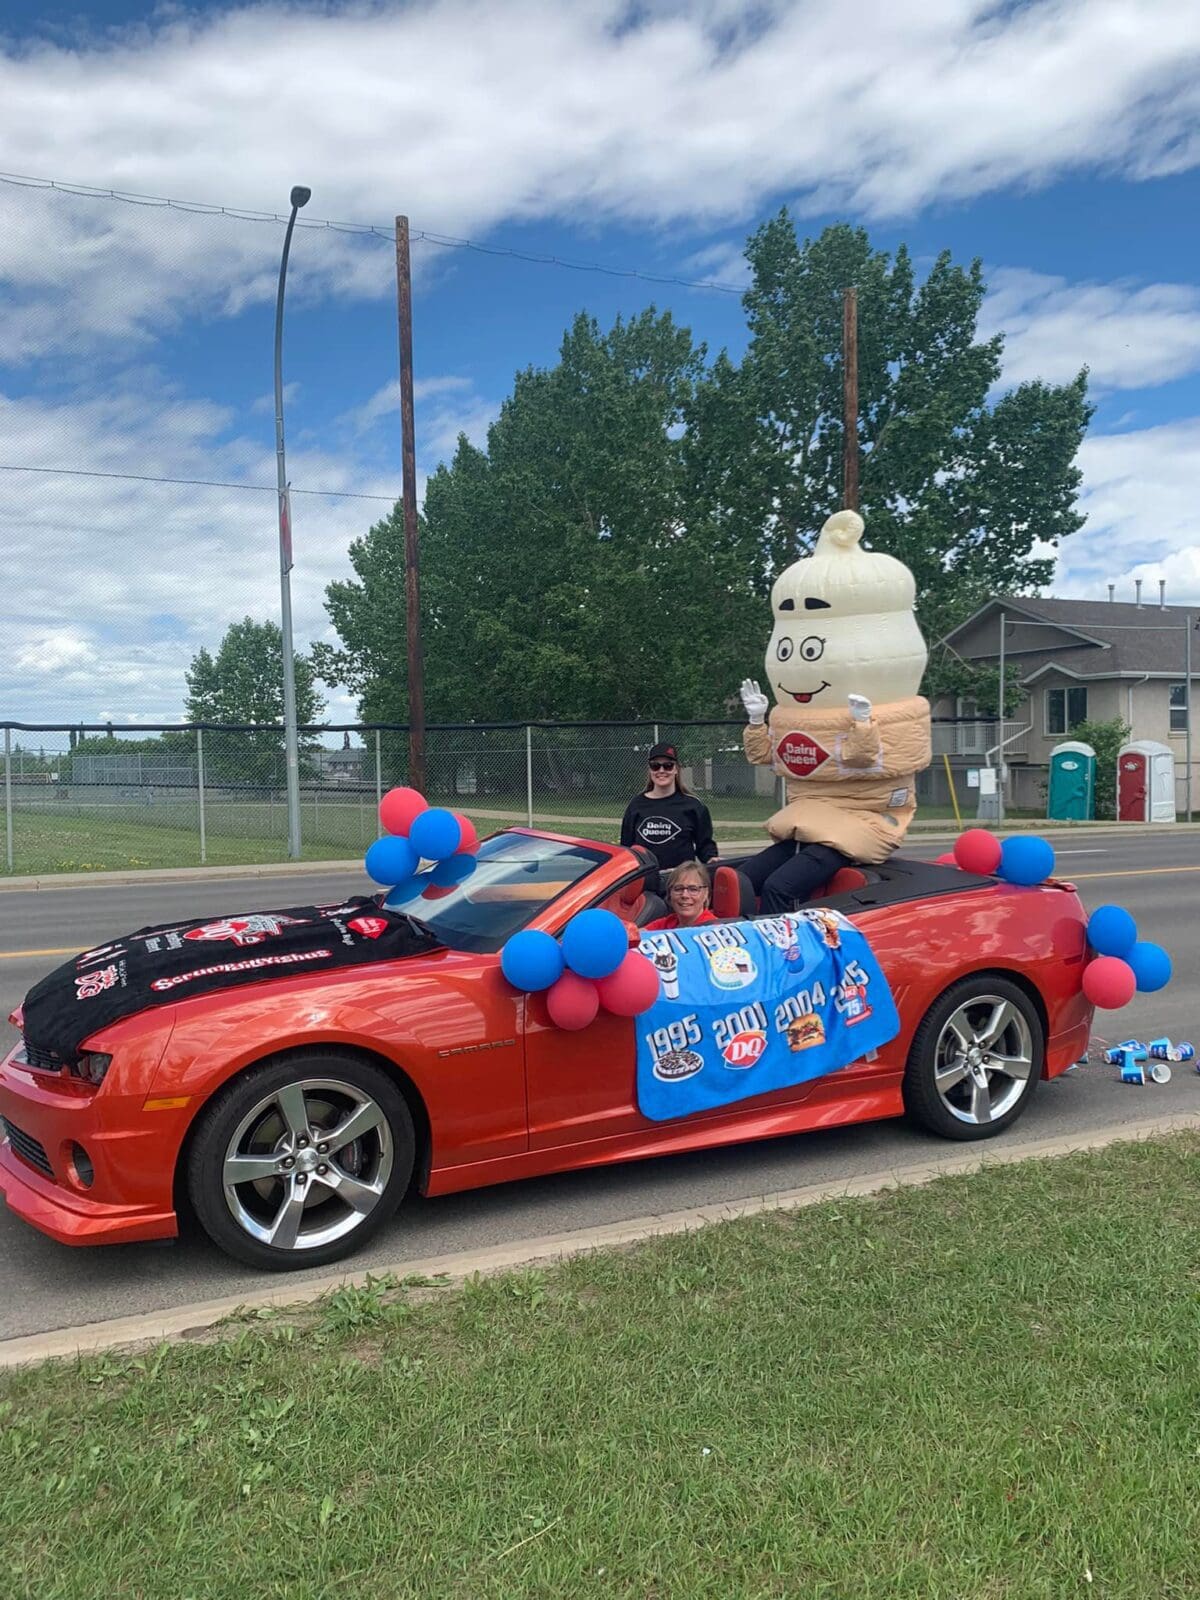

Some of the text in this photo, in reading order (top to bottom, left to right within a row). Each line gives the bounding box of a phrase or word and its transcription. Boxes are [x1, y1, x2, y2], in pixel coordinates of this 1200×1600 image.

[785, 742, 817, 757] Dairy
[783, 752, 818, 765] Queen
[642, 828, 671, 836] Queen
[646, 821, 671, 830] Dairy
[693, 926, 748, 958] 1981
[645, 1013, 702, 1061] 1995
[712, 1001, 768, 1050] 2001
[774, 981, 826, 1033] 2004
[731, 1038, 762, 1061] DQ
